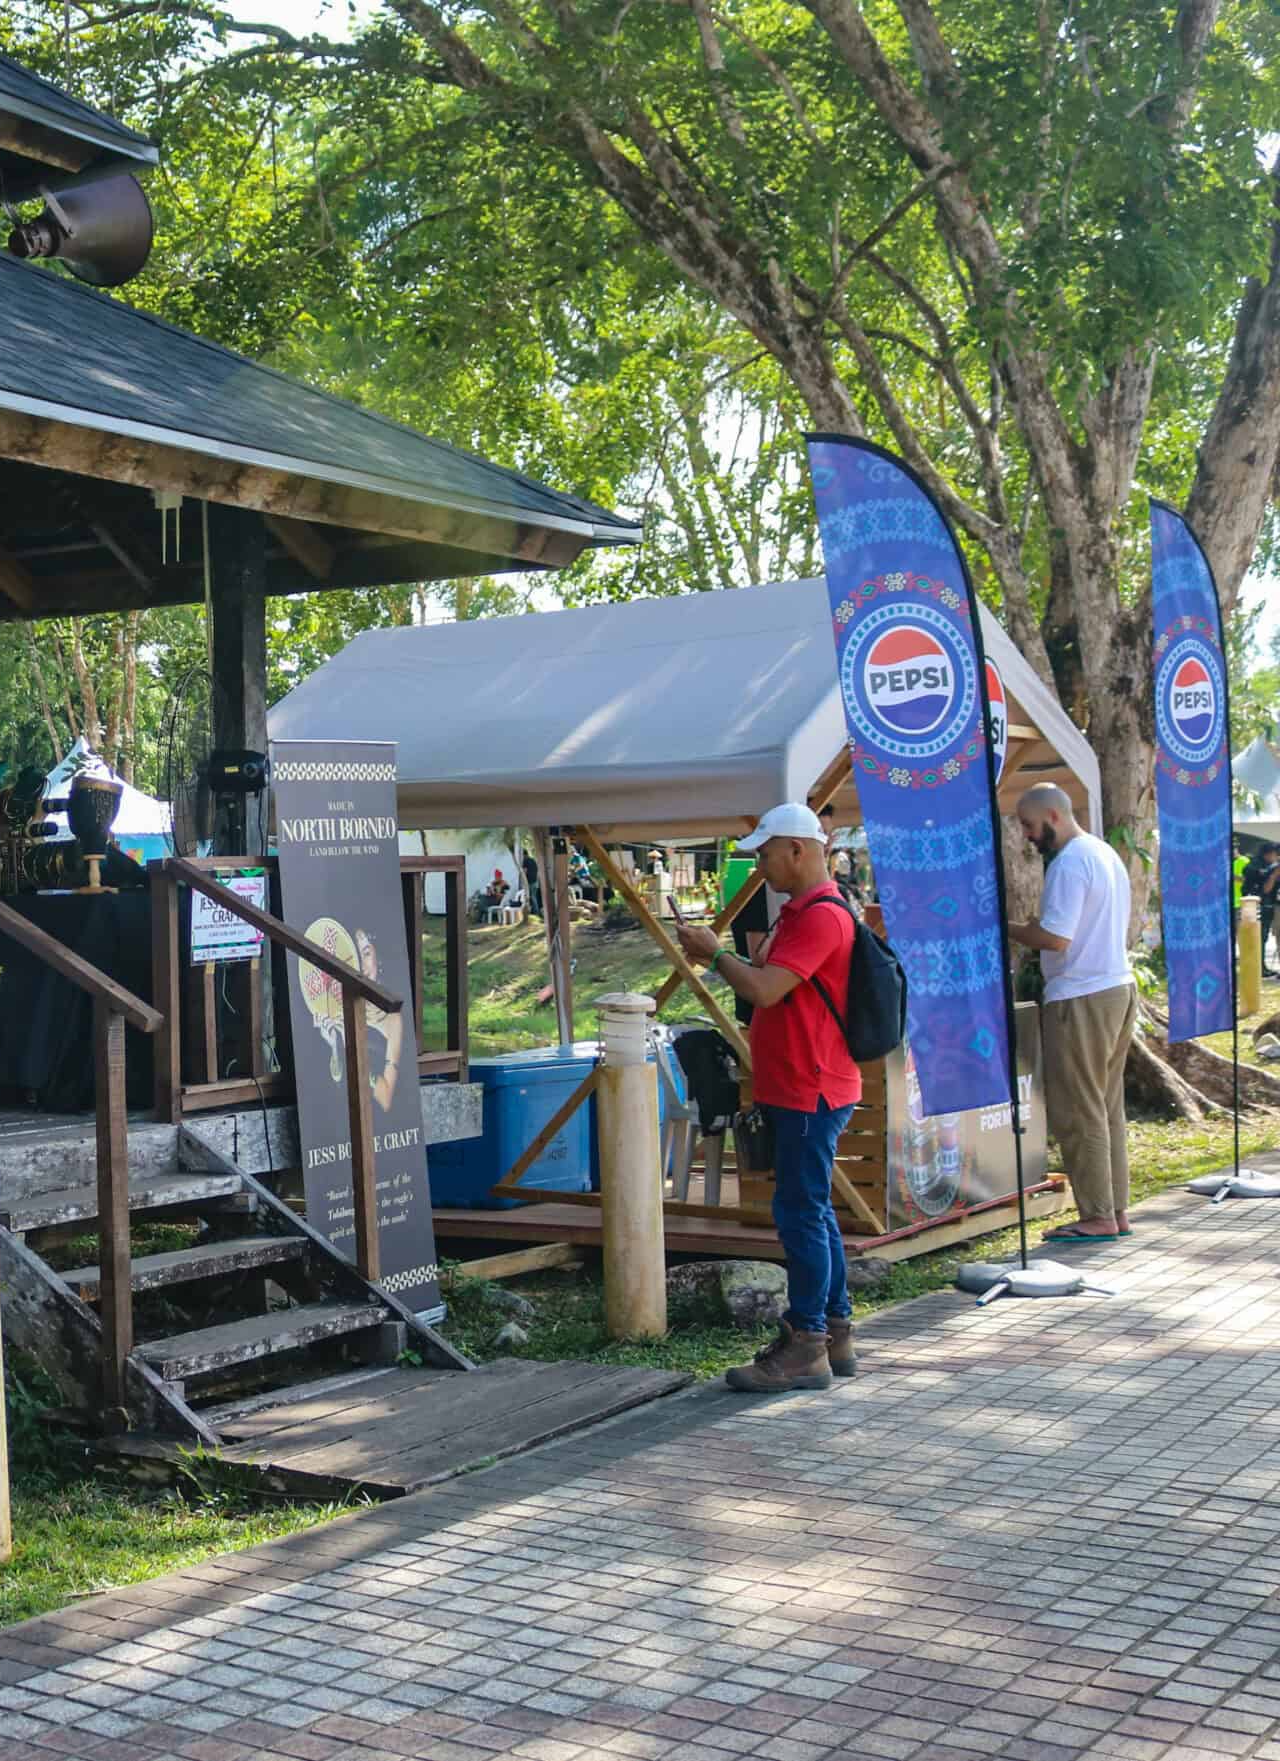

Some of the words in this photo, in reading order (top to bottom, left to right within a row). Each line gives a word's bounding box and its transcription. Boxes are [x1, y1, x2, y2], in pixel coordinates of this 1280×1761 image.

[870, 666, 949, 694] PEPSI
[1174, 691, 1212, 710] PEPSI
[281, 818, 336, 843] NORTH
[340, 816, 396, 840] BORNEO
[308, 1145, 336, 1168] JESS
[383, 1128, 419, 1150] CRAFT
